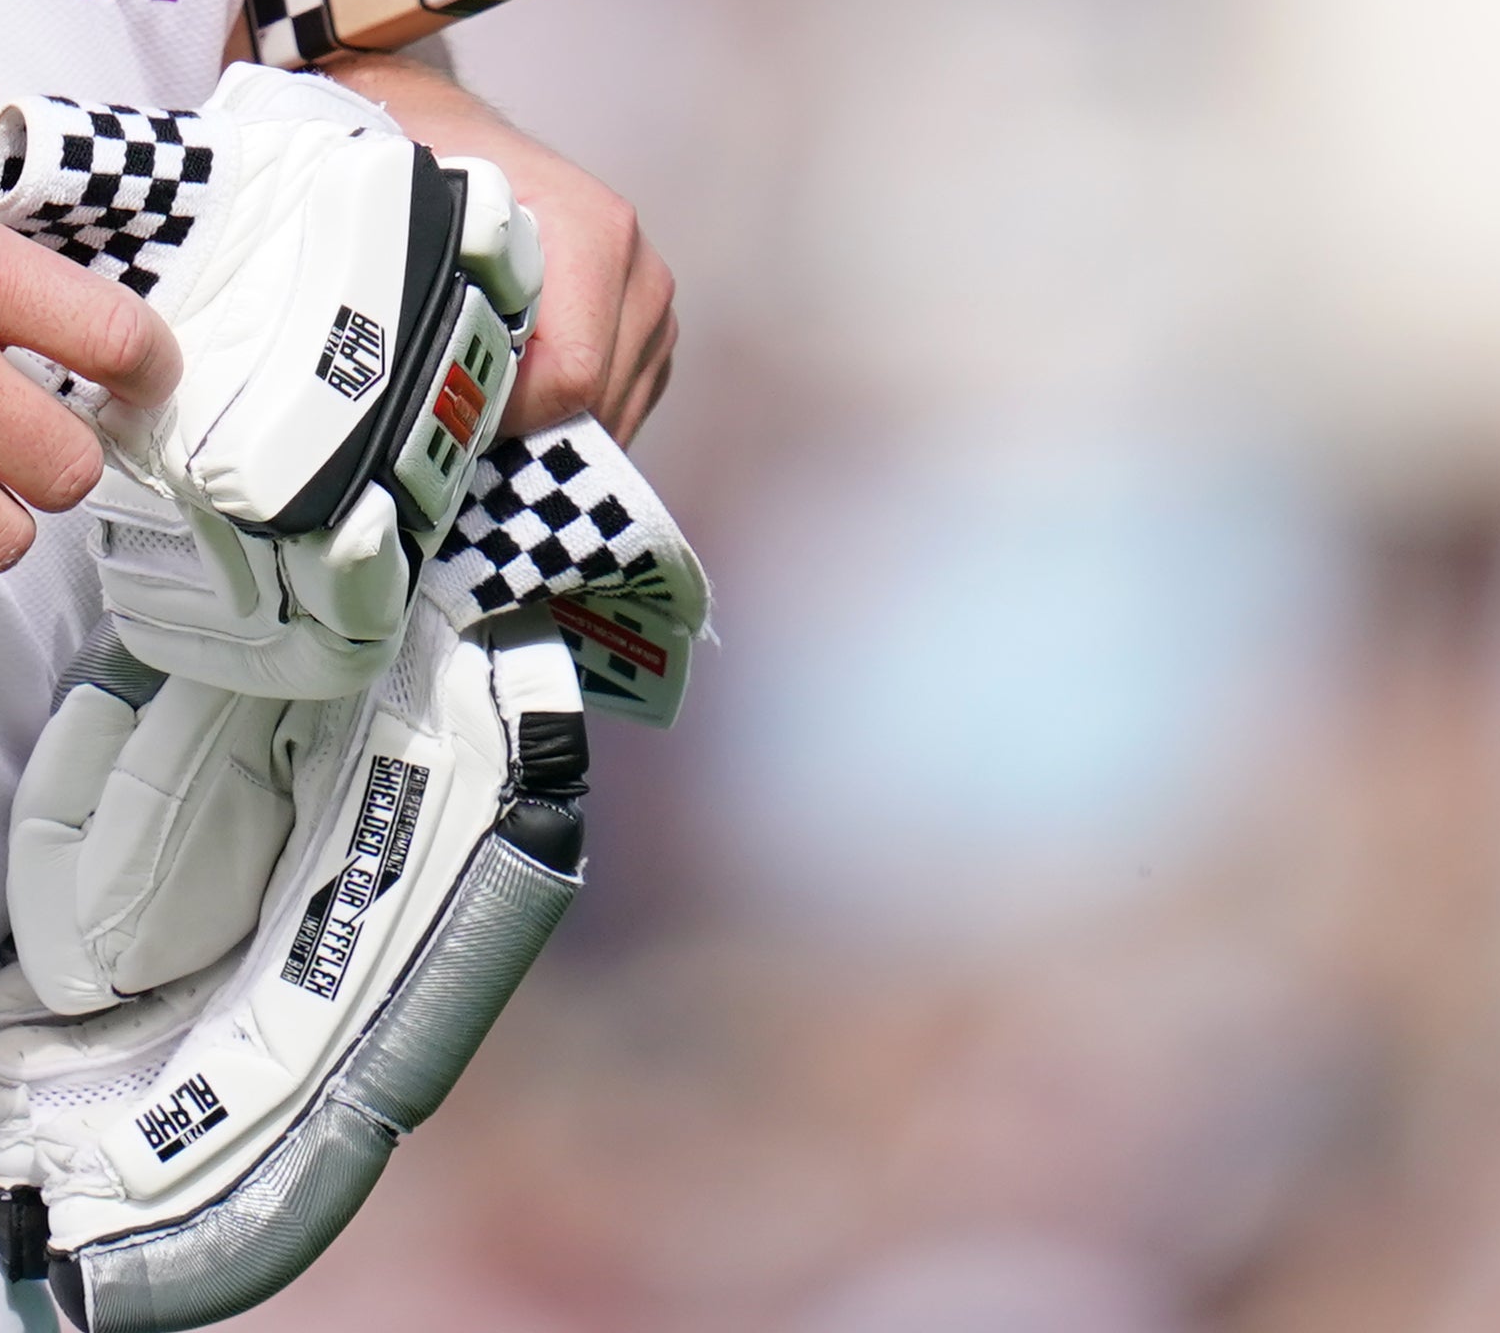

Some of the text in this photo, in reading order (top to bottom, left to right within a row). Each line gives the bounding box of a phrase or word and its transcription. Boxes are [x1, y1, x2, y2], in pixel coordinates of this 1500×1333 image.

[327, 311, 380, 399] ALPHA
[354, 756, 404, 858] SHIELDED
[135, 1072, 220, 1150] ALPHA
